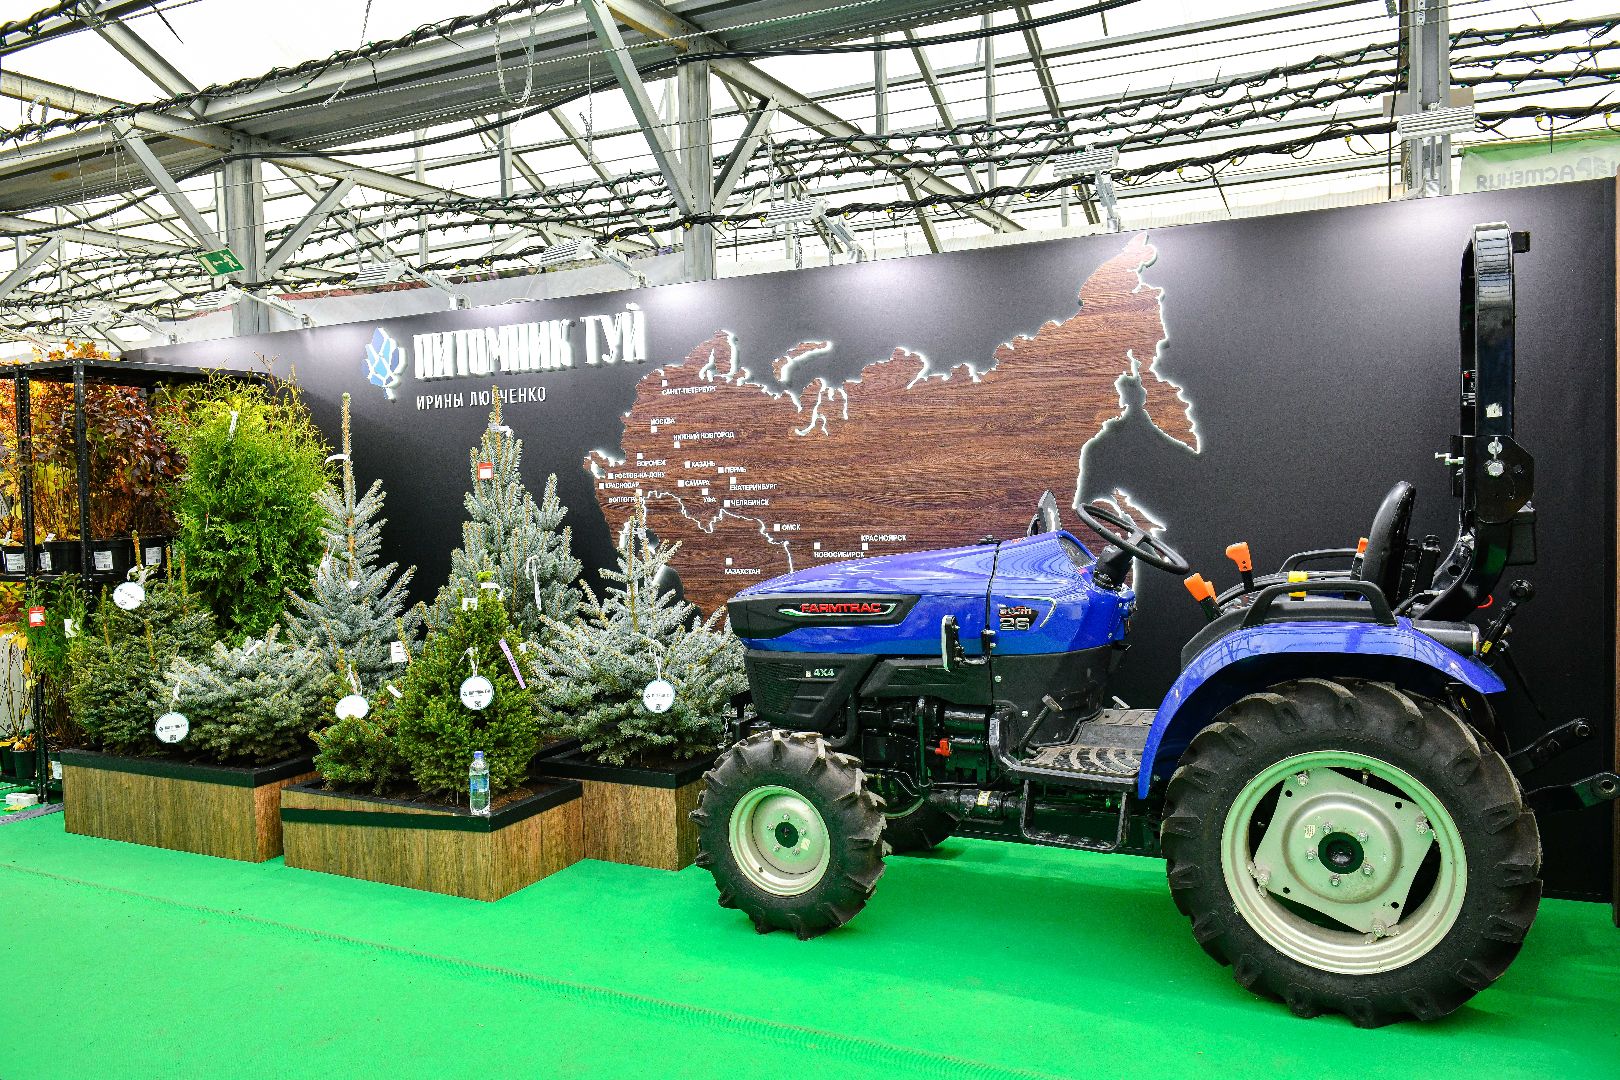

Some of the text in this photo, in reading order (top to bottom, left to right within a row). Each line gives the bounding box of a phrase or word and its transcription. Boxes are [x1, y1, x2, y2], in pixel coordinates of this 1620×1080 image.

[413, 302, 646, 379] ПИТОМНИК ТУЙ
[662, 386, 717, 395] САНКТ-ПЕТЕРБУРГ
[416, 391, 464, 411] ИРИНЫ
[673, 431, 735, 441] НИЖНИЙ НОВГОРОД
[691, 460, 716, 468] КАЗАНЬ
[684, 479, 711, 487] САМАРА
[730, 483, 777, 491] ЕКАТЕРИНБУРГ
[608, 496, 645, 504] ВОЛГОГРД
[703, 496, 717, 504] УФА
[731, 498, 770, 506] ЧЕЛЯБИНСК
[781, 523, 801, 531] ОМСК
[861, 534, 907, 542] КРАСНОЯРСК
[800, 602, 881, 613] FARMTRAC
[1000, 617, 1030, 631] 26
